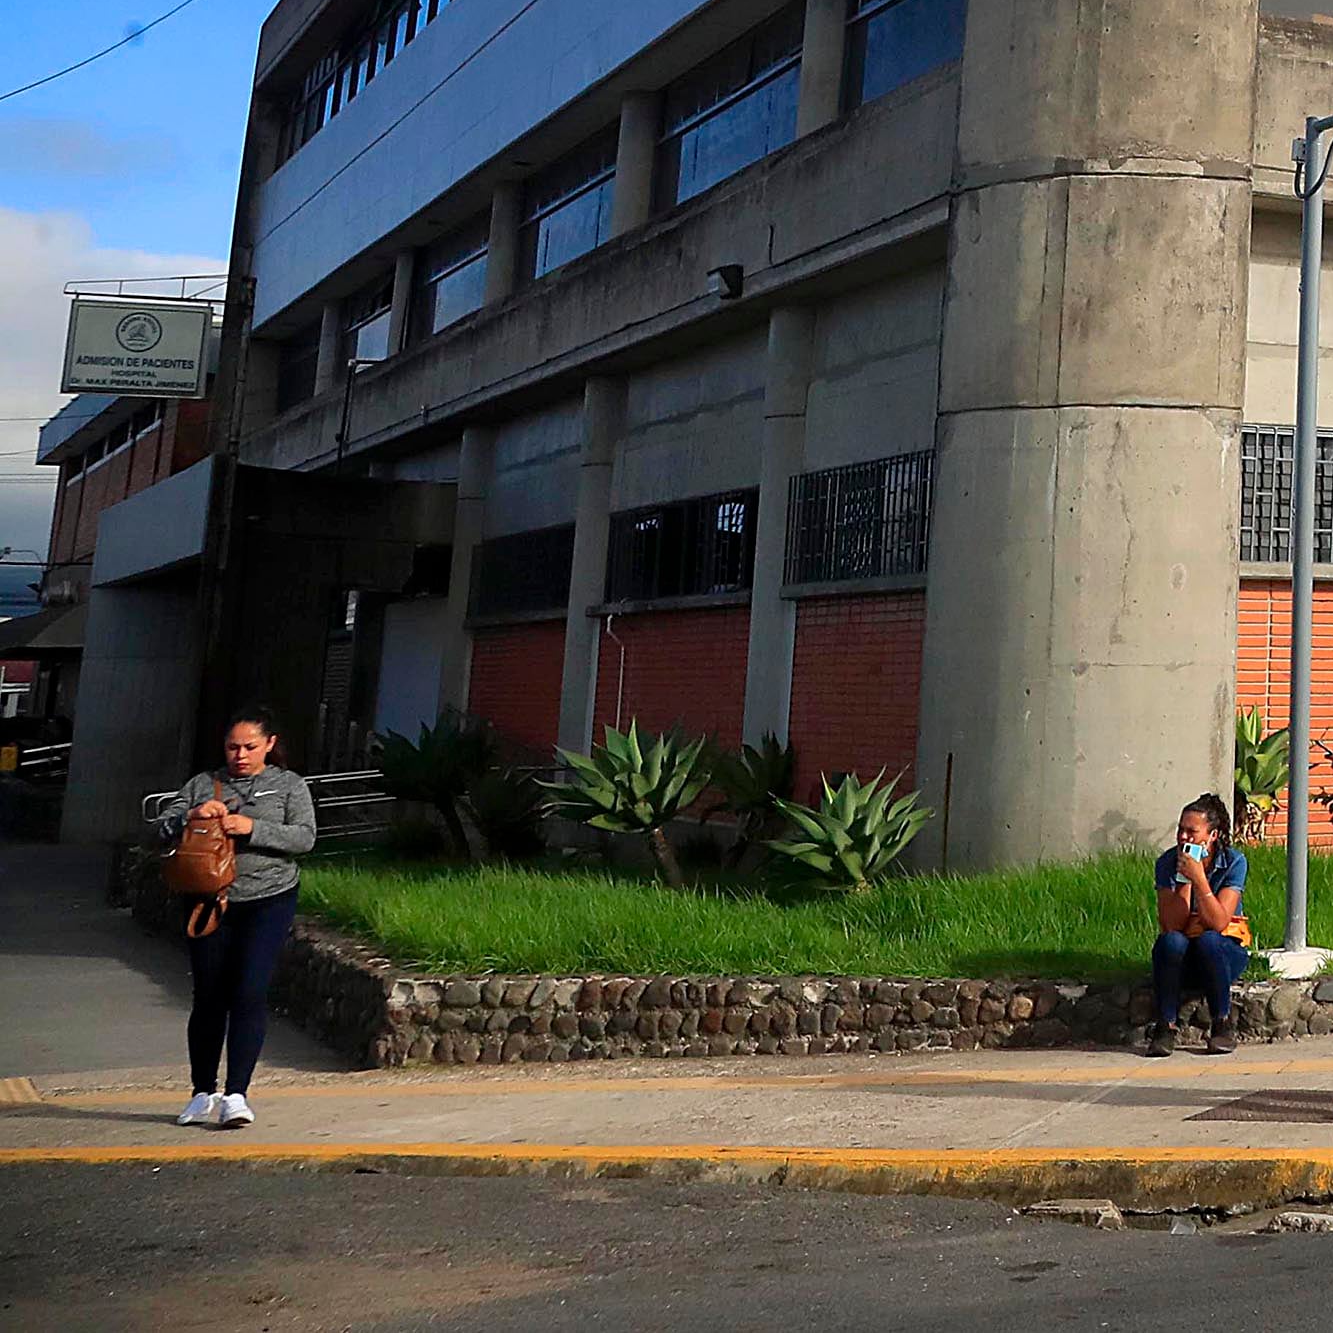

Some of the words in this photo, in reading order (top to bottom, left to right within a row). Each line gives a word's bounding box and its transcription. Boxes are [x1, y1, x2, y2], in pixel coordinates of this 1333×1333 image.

[76, 355, 124, 366] ADMISION
[127, 357, 140, 367] DE
[142, 358, 195, 370] PACIENTES
[111, 370, 157, 378] HOSPITAL
[85, 378, 107, 386] MAX
[110, 379, 153, 387] PERALTA
